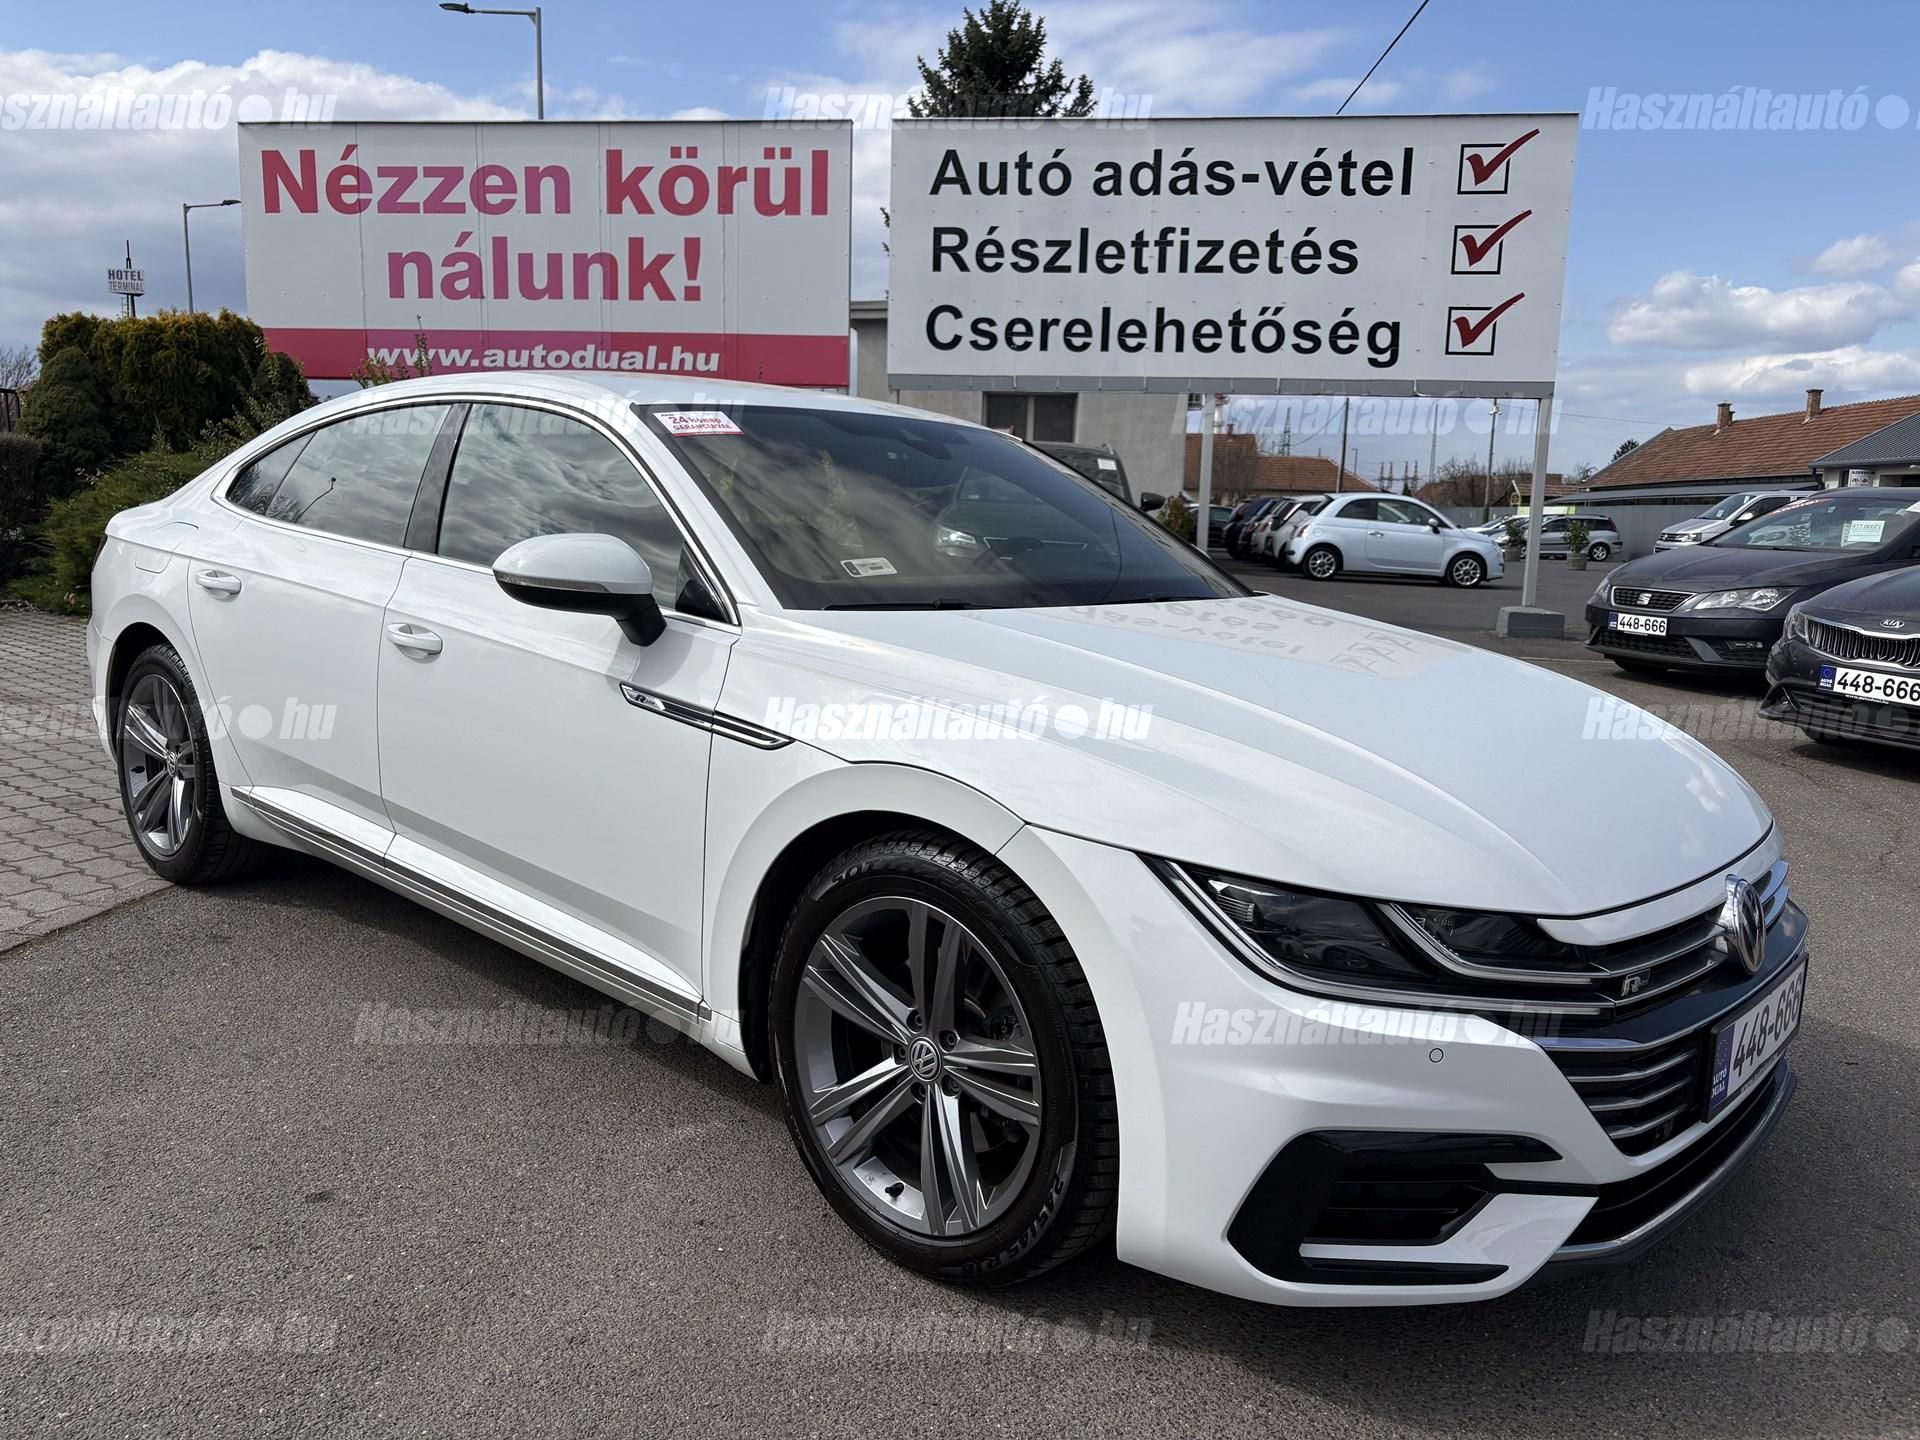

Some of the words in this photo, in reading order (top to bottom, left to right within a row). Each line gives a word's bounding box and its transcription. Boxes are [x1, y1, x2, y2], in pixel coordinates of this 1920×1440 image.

[261, 145, 570, 214] Nézzen
[607, 147, 829, 216] körül
[929, 149, 1072, 196] Autó
[1092, 147, 1414, 196] adás-vétel
[932, 226, 1359, 275] Részletfizetés
[108, 270, 144, 281] HOTEL
[388, 232, 702, 302] nálunk!
[109, 281, 144, 292] TERMINAL
[926, 304, 1401, 368] Cserelehetőség
[367, 344, 720, 372] www.autodual.hu
[669, 416, 688, 424] 24
[1619, 616, 1666, 633] 448-666
[1883, 619, 1900, 628] KIA
[1837, 671, 1920, 702] 448-666
[1733, 972, 1803, 1077] 448-666
